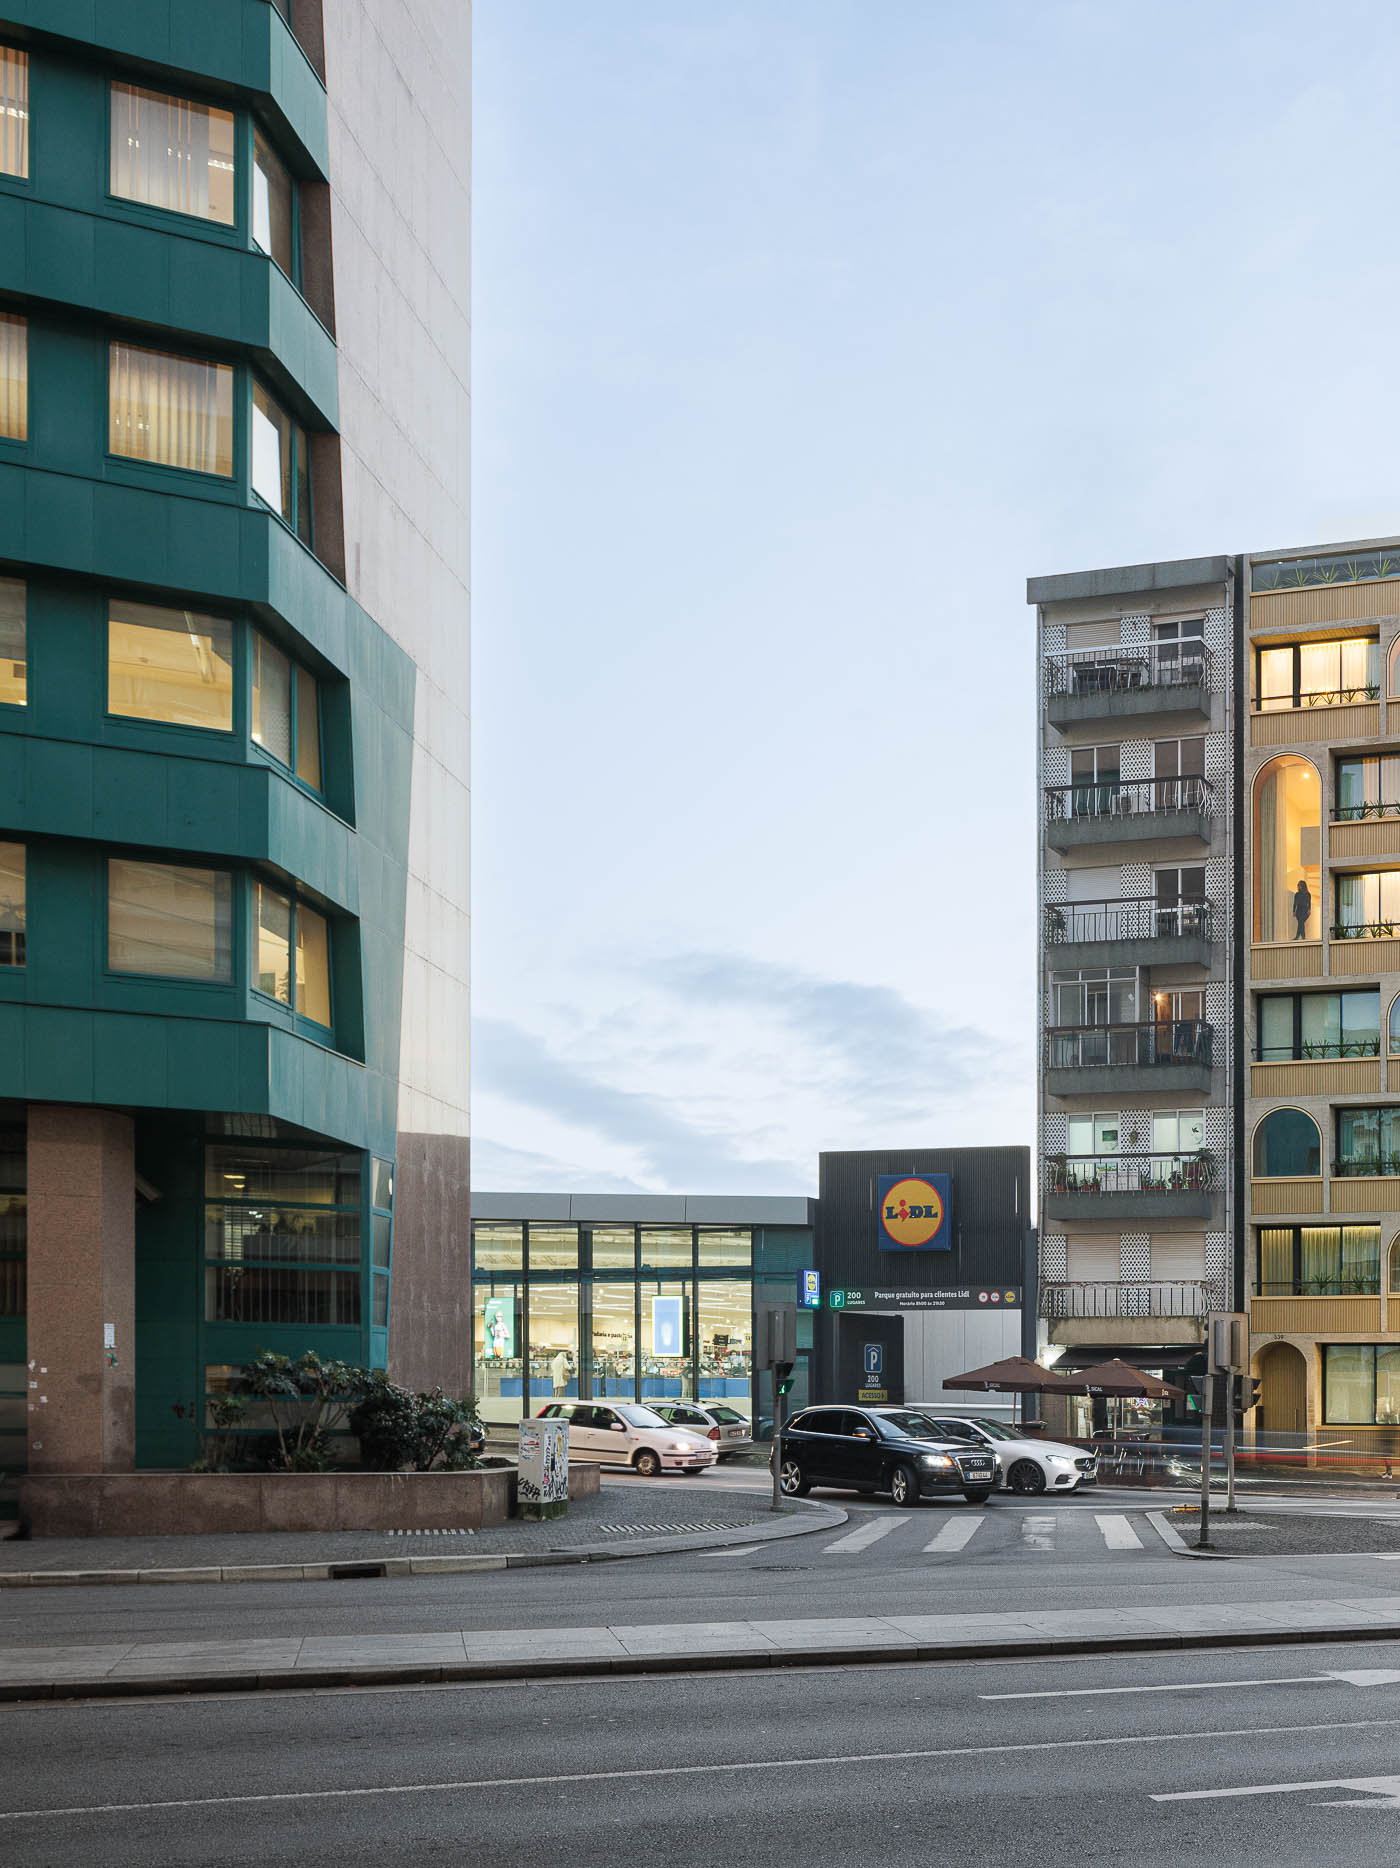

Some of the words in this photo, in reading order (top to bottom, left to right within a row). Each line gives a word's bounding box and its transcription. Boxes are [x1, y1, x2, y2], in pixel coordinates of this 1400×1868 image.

[896, 1291, 919, 1299] gratuito
[934, 1290, 957, 1298] clientes
[958, 1290, 970, 1298] Lidl
[870, 1351, 878, 1370] P
[867, 1375, 879, 1383] 200
